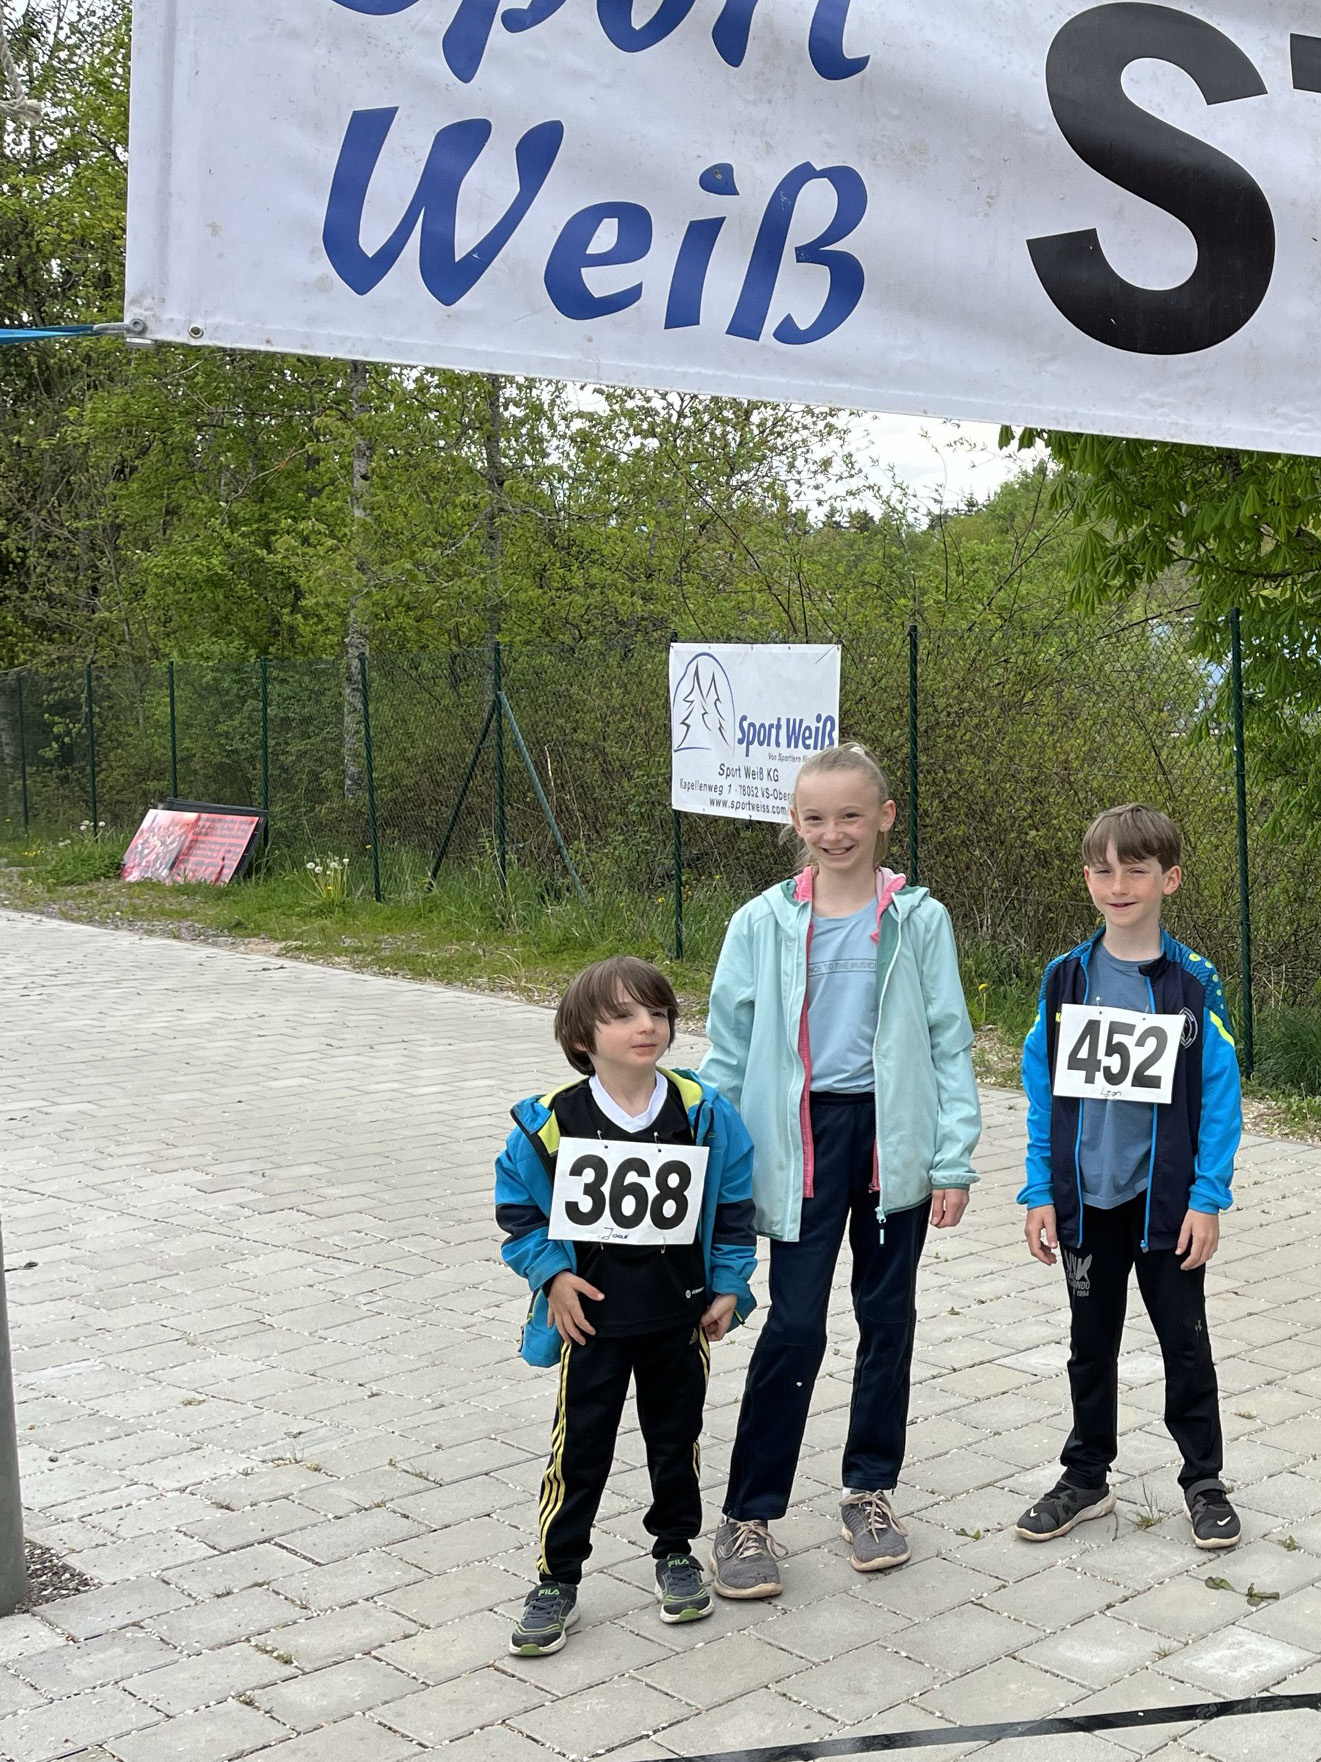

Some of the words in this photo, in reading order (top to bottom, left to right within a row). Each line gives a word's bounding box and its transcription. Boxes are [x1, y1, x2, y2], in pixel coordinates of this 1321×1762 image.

[323, 106, 868, 345] Weiß
[737, 715, 782, 757] Sport
[786, 713, 836, 750] Weiß
[680, 778, 724, 795] Kapellenweg
[739, 785, 759, 798] 78052
[718, 763, 741, 779] Sport
[744, 765, 763, 780] Weiß
[767, 768, 779, 782] KG
[710, 798, 786, 814] www.sportweiss.com
[1067, 1019, 1168, 1089] 452
[564, 1154, 692, 1230] 368
[668, 1559, 689, 1567] FILA
